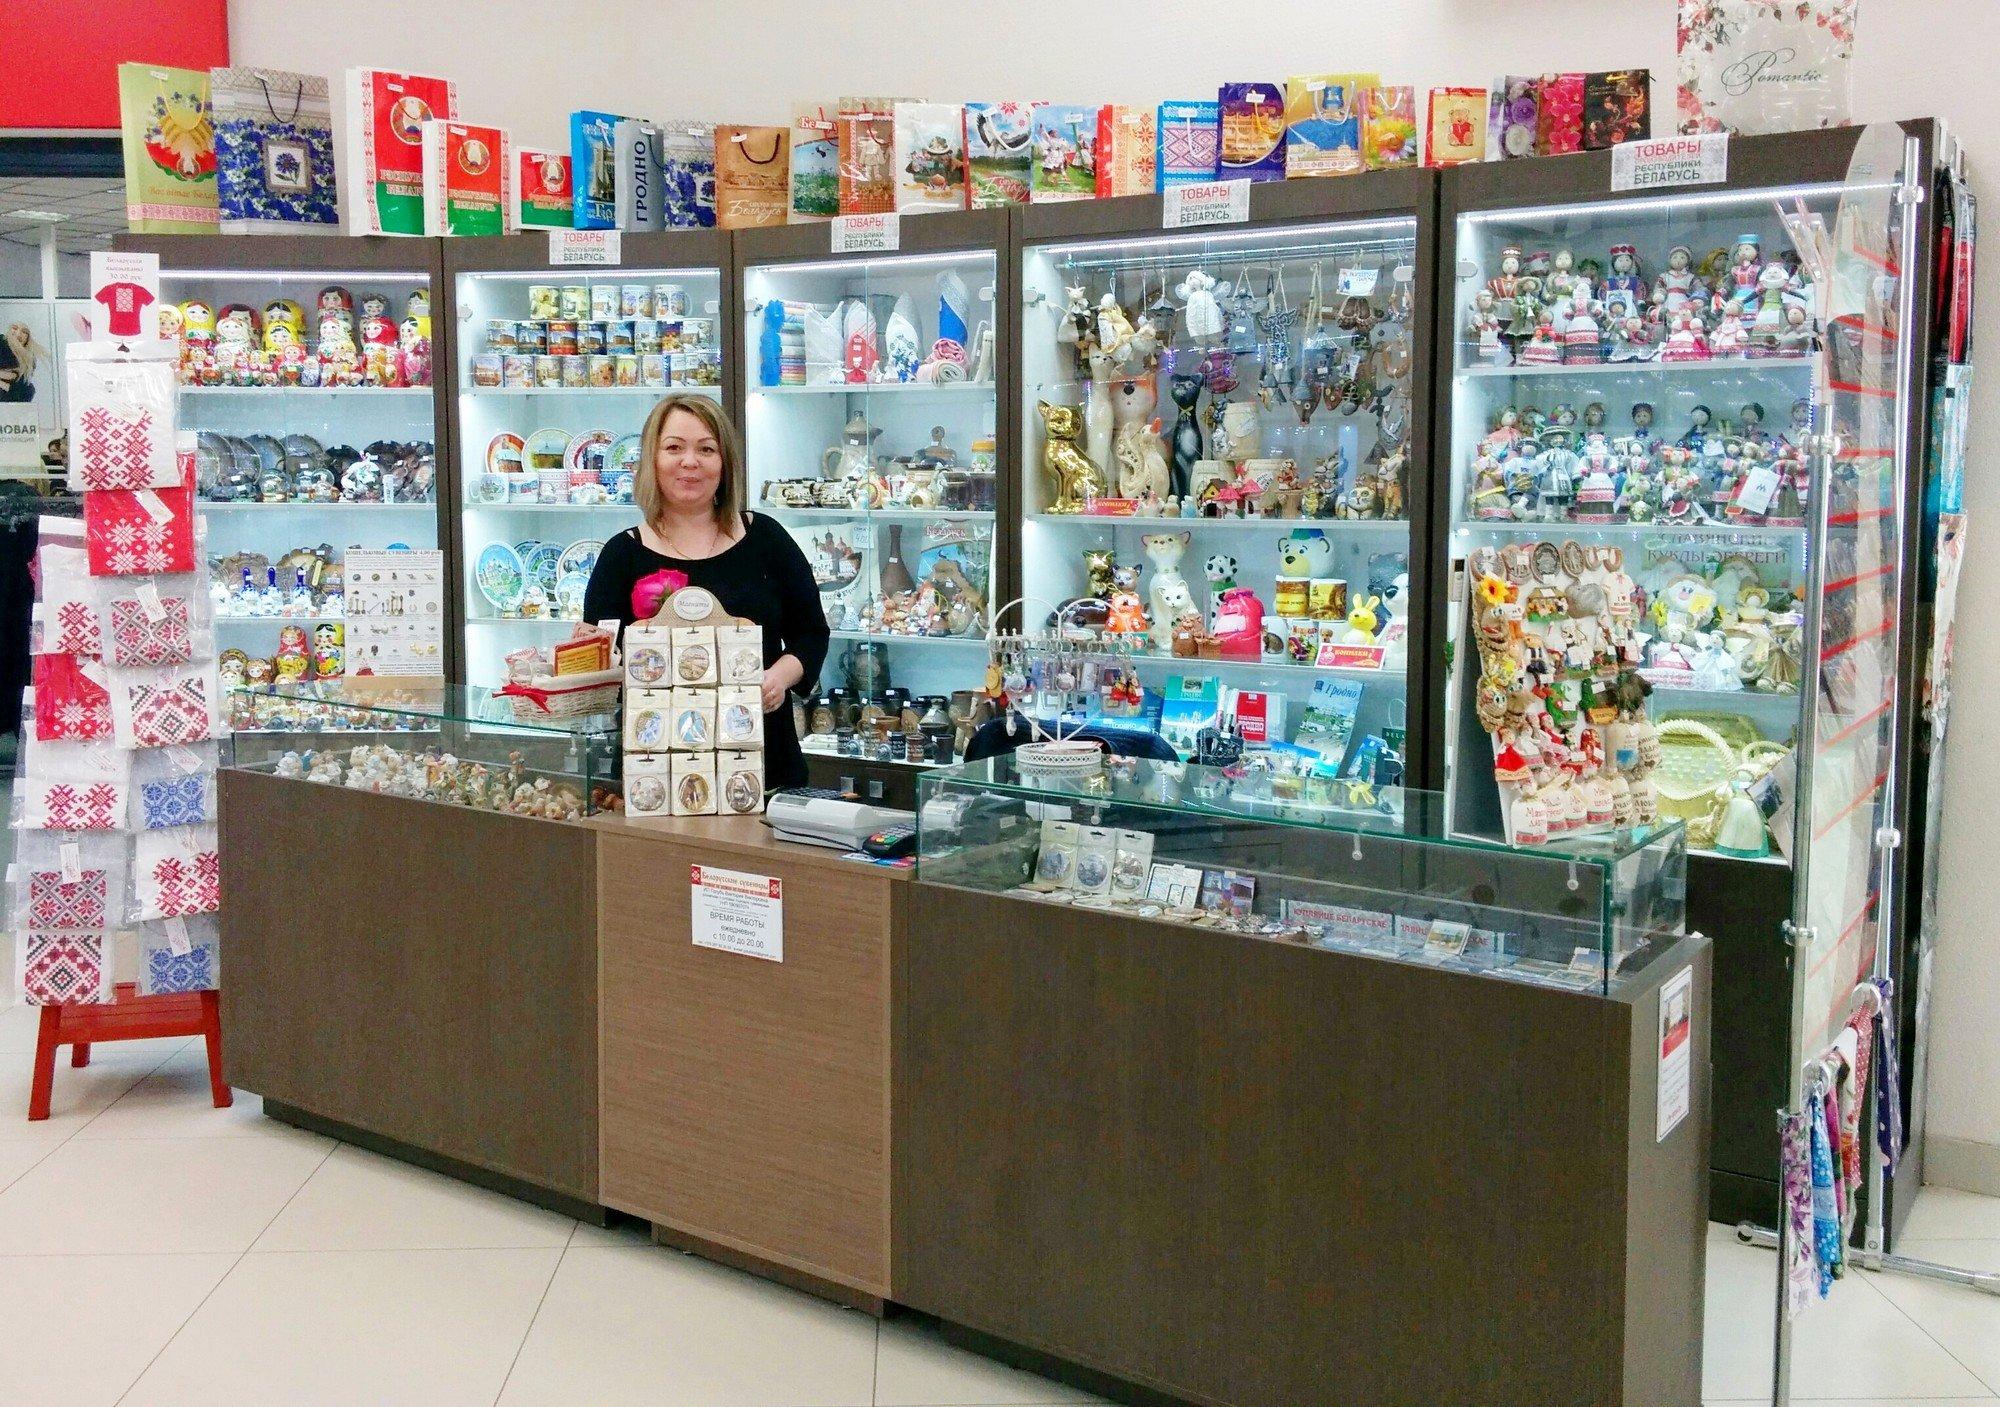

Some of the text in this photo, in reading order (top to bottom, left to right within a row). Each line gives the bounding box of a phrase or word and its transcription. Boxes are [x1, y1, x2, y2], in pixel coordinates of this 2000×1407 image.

[1720, 47, 1821, 96] Romantic
[1634, 141, 1701, 158] ТОВАРЫ
[1634, 160, 1702, 172] РЕСПУБЛИКИ
[633, 140, 649, 222] ГРОДНО
[1633, 169, 1700, 185] БЕЛАРУСЬ
[1180, 186, 1231, 200] ТОВАРЫ
[1180, 203, 1231, 212] РЕСПУБЛИКИ
[845, 217, 884, 228] ТОВАРЫ
[1180, 210, 1230, 224] БЕЛАРУСЬ
[563, 232, 606, 243] ТОВАРЫ
[844, 239, 885, 249] БЕЛАРУСЬ
[563, 253, 605, 261] БЕЛАРУСЬ
[1325, 682, 1358, 699] Гродно
[709, 911, 765, 929] ВРЕМЯ РАБОТЫ
[720, 925, 756, 937] ежедневно
